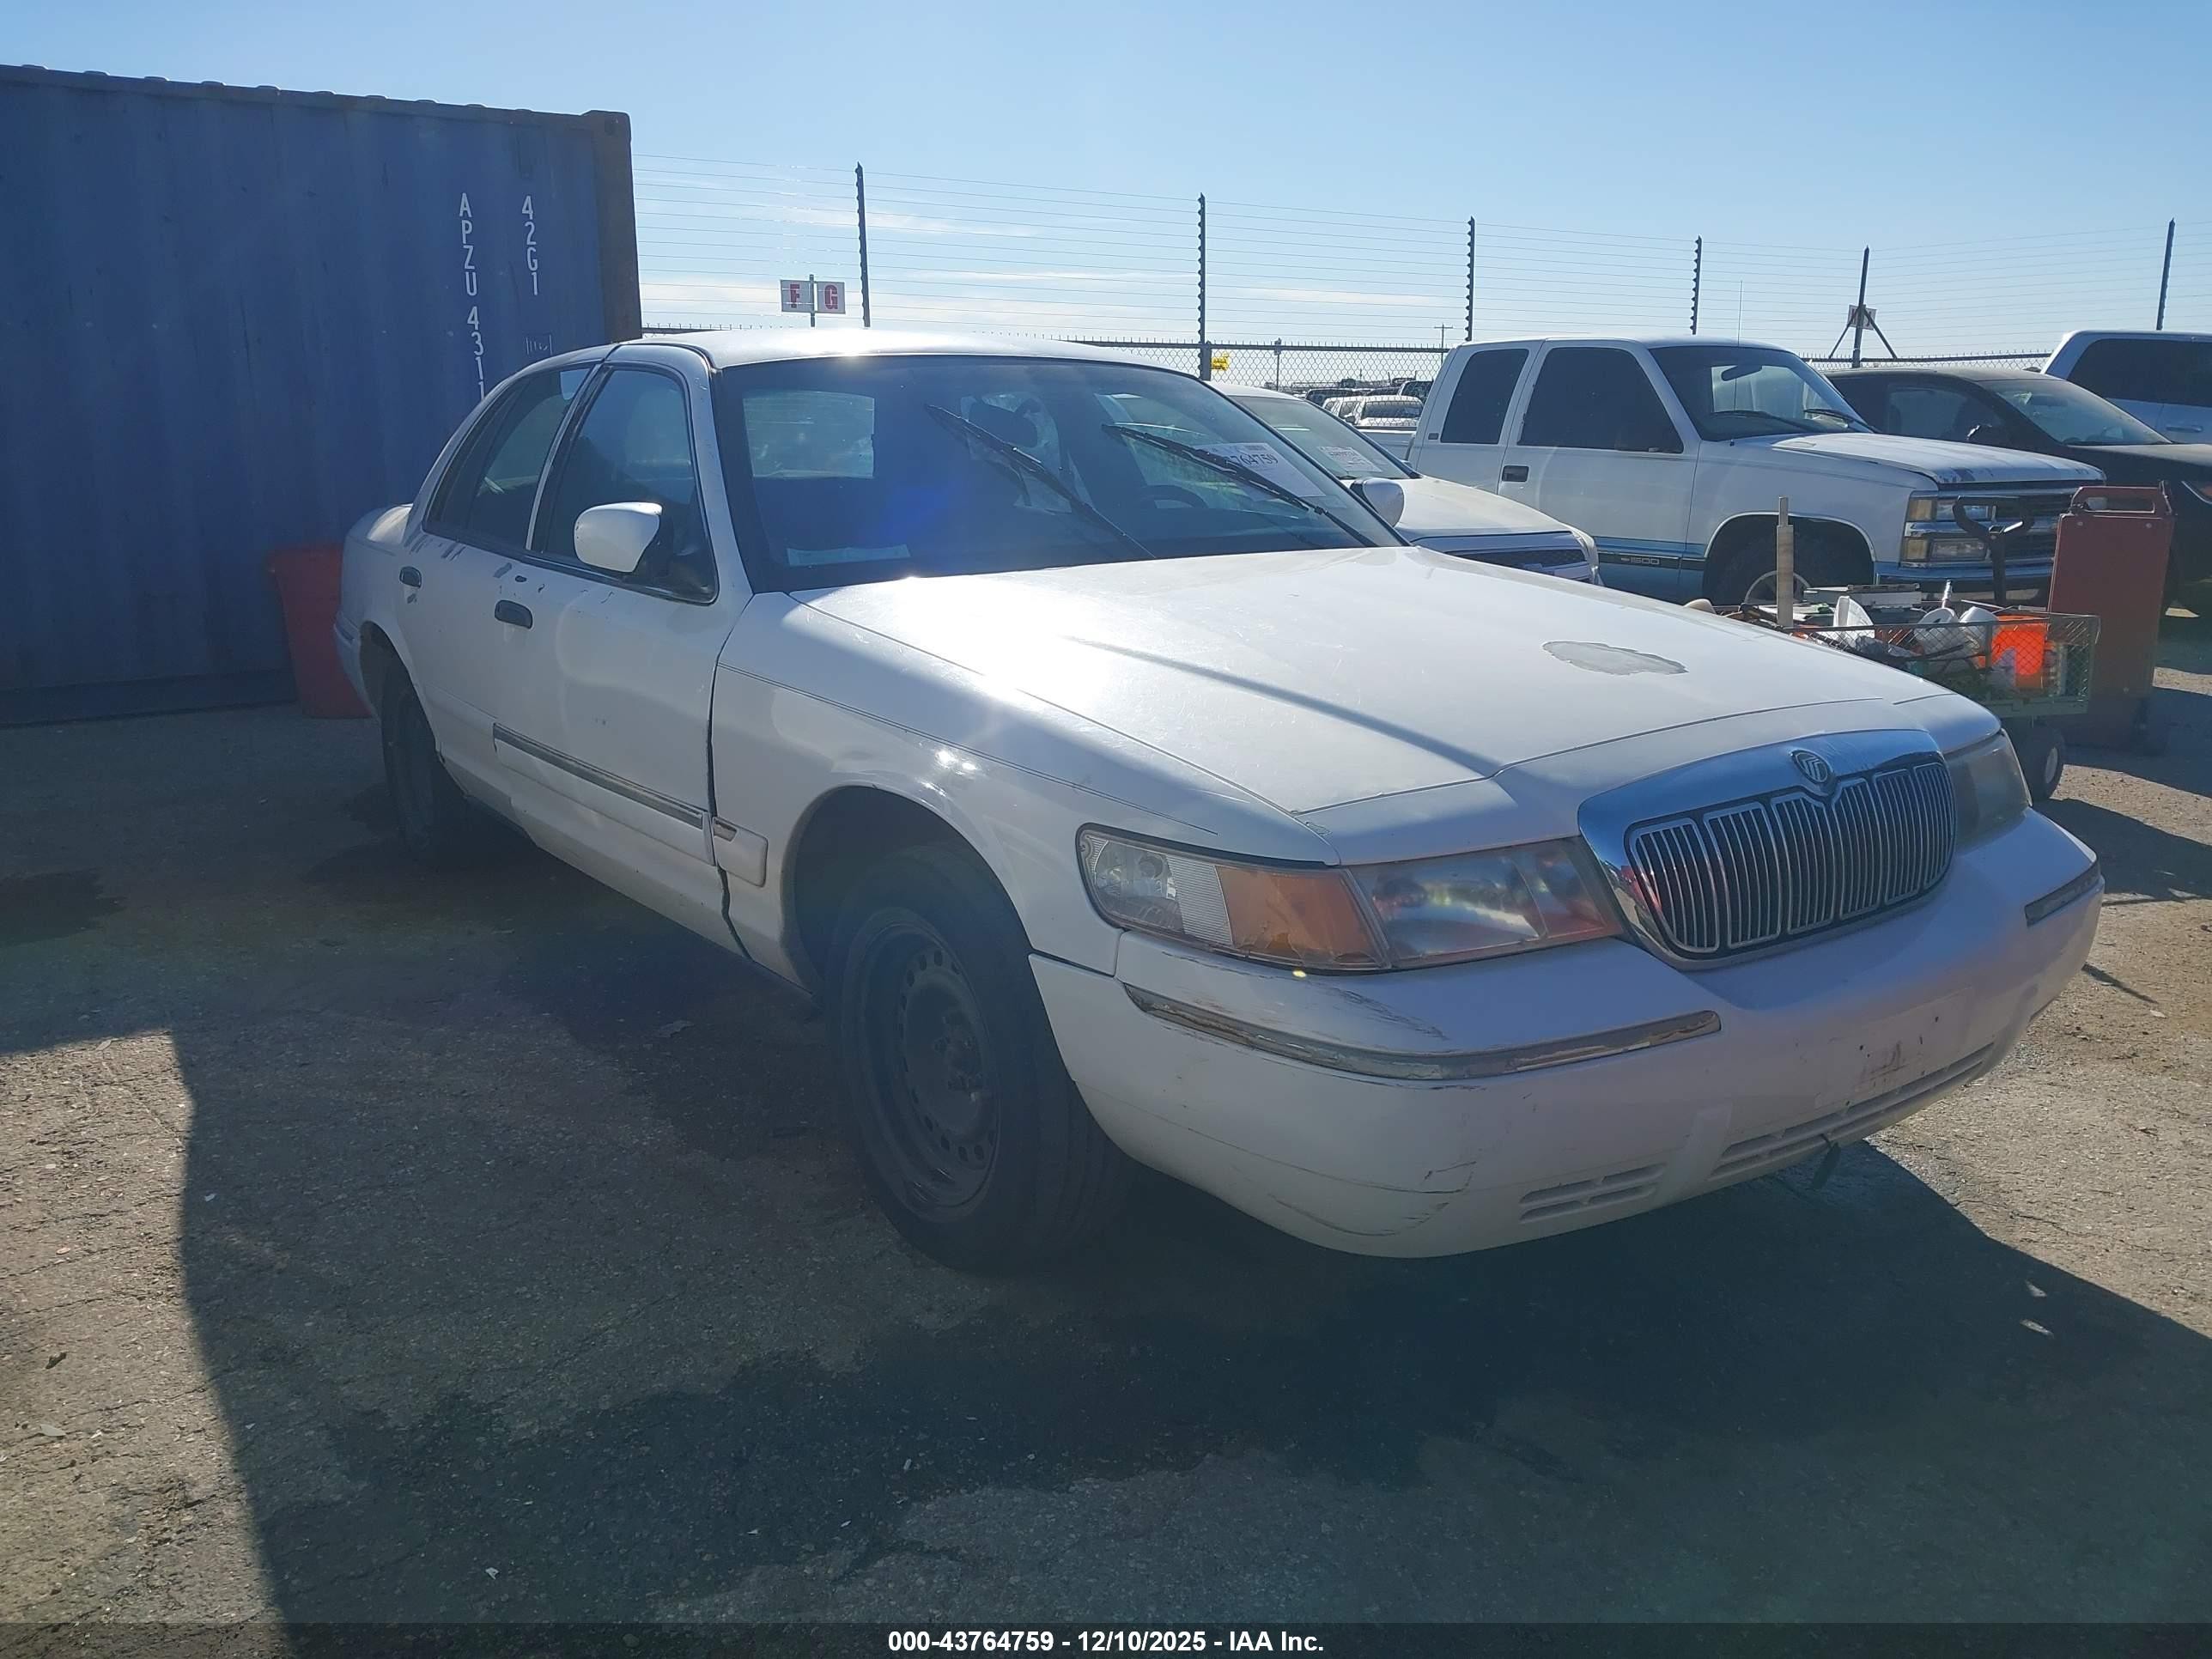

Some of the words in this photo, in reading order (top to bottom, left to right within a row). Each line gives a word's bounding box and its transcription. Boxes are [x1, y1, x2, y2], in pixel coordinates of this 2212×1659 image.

[459, 191, 477, 296] APZU
[521, 195, 538, 295] 42G1
[789, 283, 800, 308] F
[824, 284, 838, 309] G
